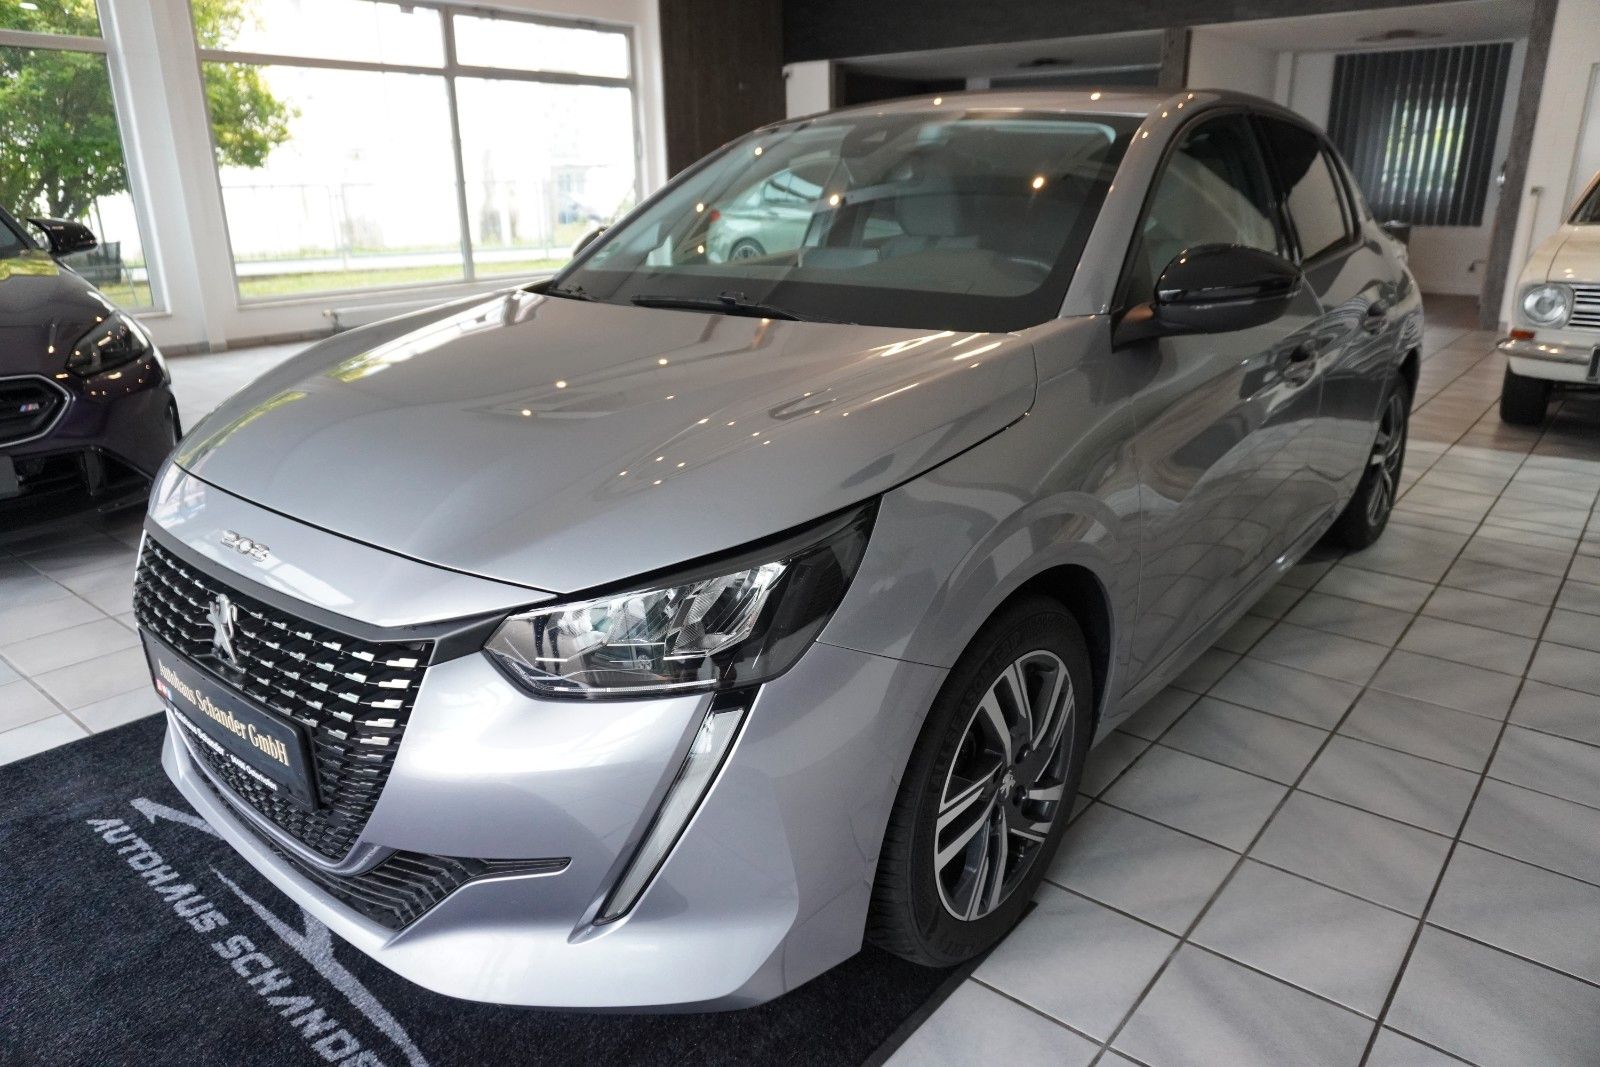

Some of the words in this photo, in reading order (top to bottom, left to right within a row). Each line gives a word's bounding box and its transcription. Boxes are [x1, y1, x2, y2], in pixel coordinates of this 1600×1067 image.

[220, 529, 270, 562] 208
[195, 689, 247, 740] Schander
[247, 723, 291, 767] GmbH
[86, 818, 230, 933] AUTOHAUS
